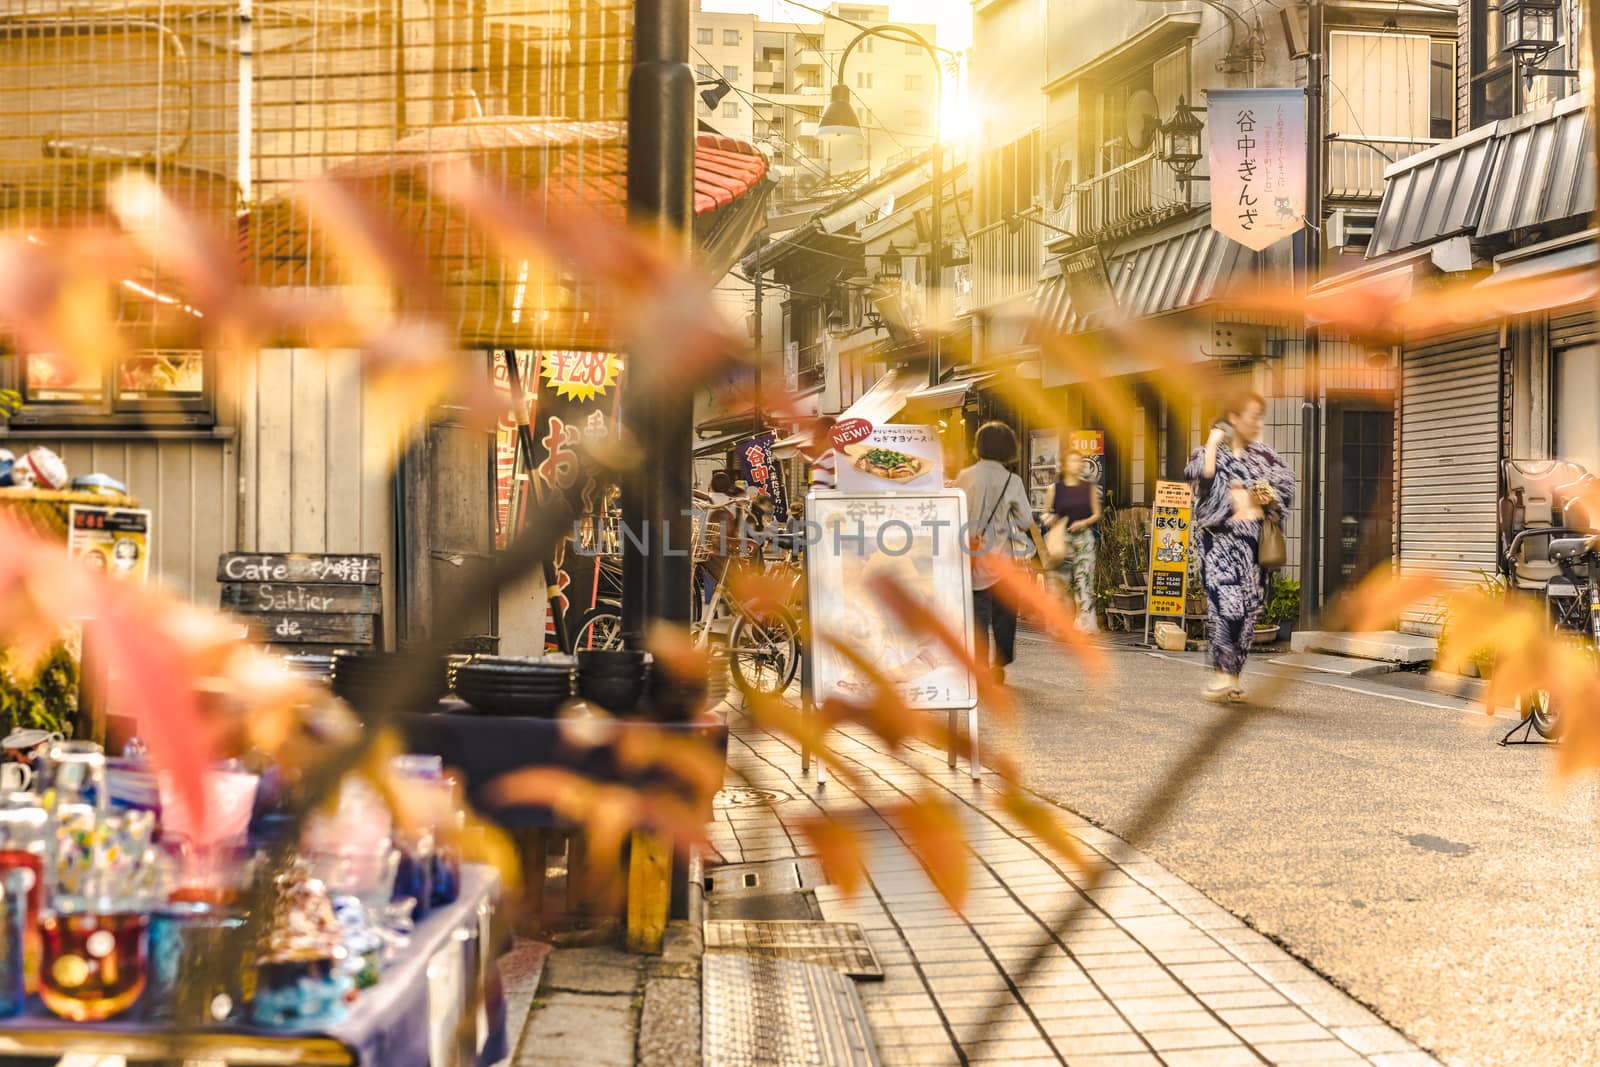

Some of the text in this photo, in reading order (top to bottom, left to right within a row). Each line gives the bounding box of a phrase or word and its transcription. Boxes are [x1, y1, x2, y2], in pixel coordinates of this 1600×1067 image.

[1236, 109, 1258, 230] 谷中ぎんざ
[832, 425, 870, 445] NEW!!
[1156, 517, 1187, 529] ほぐし
[225, 556, 289, 580] Cafe
[276, 617, 302, 636] de
